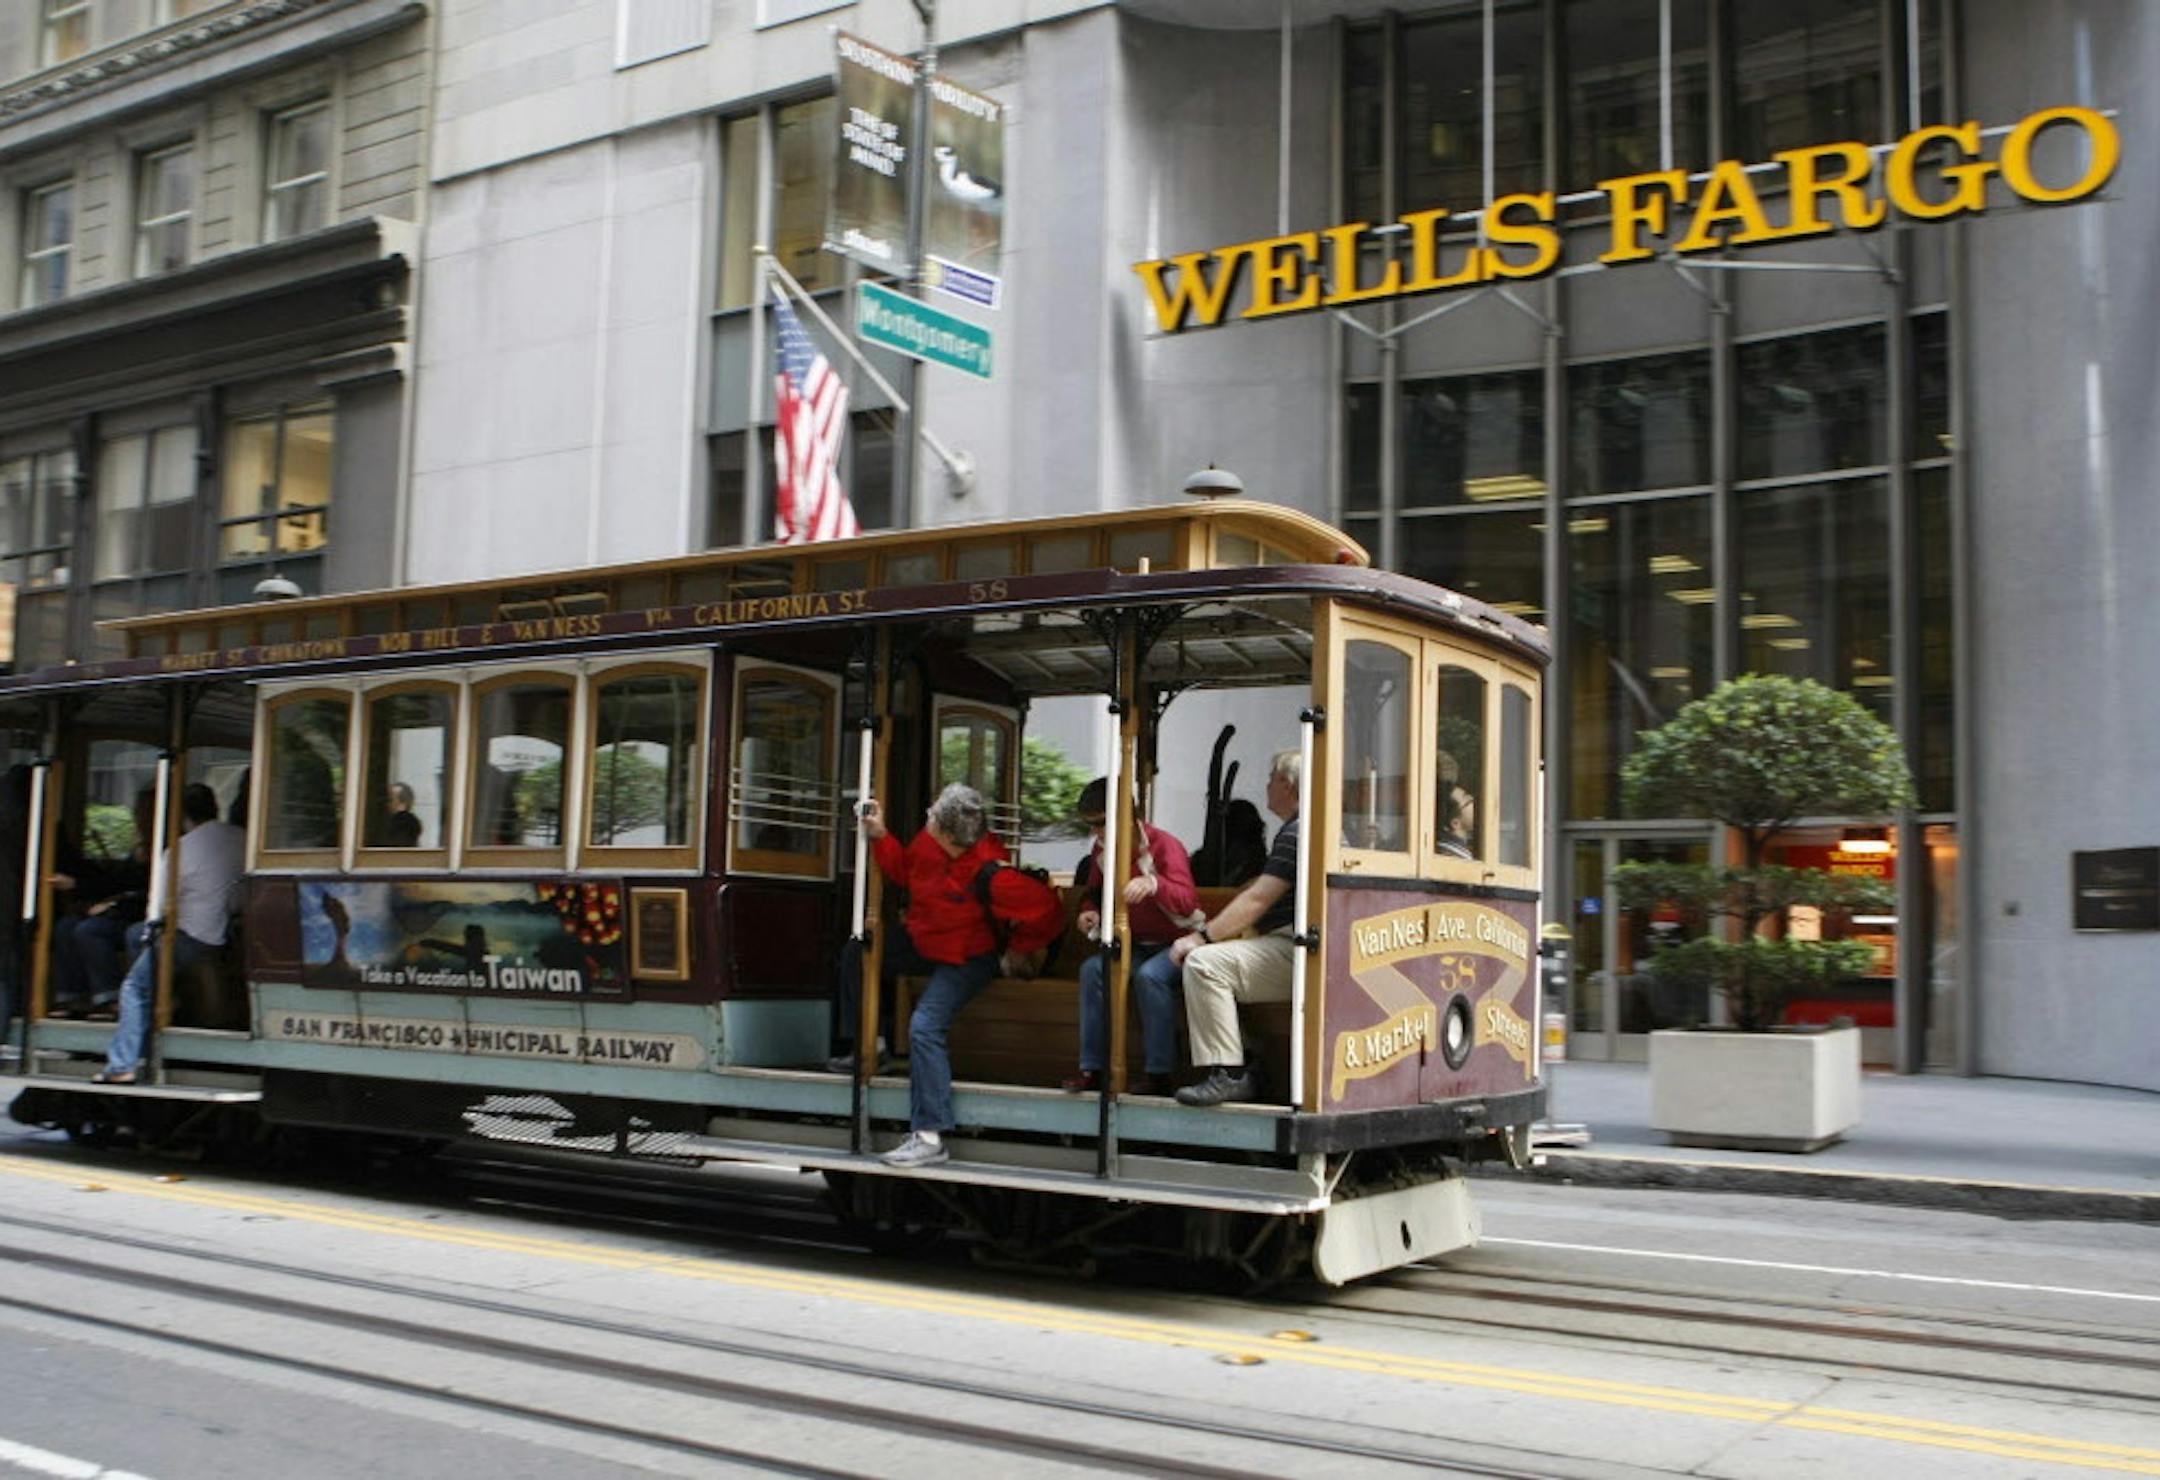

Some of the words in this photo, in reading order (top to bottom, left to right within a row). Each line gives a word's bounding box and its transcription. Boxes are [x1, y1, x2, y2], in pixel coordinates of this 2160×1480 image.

[1132, 192, 1560, 332] WELLS
[1599, 106, 2121, 265] FARGO
[861, 297, 992, 373] Montgomery
[969, 579, 1008, 602] 58
[423, 628, 460, 647] HILL
[513, 619, 548, 640] VAN
[553, 614, 601, 637] NESS
[694, 594, 829, 625] CALIFORNIA
[1356, 926, 1391, 958] Van
[1436, 912, 1471, 940] Ave.
[361, 965, 392, 984] Take
[394, 972, 405, 985] a
[405, 966, 469, 988] Vacation
[469, 970, 486, 988] to
[483, 955, 582, 992] Taiwan
[1439, 955, 1476, 992] 58
[282, 1017, 322, 1038] SAN
[330, 1020, 443, 1046] FRANCISCO
[576, 1036, 674, 1064] RAILWAY
[1345, 1035, 1361, 1068] &
[1364, 1011, 1429, 1065] Market
